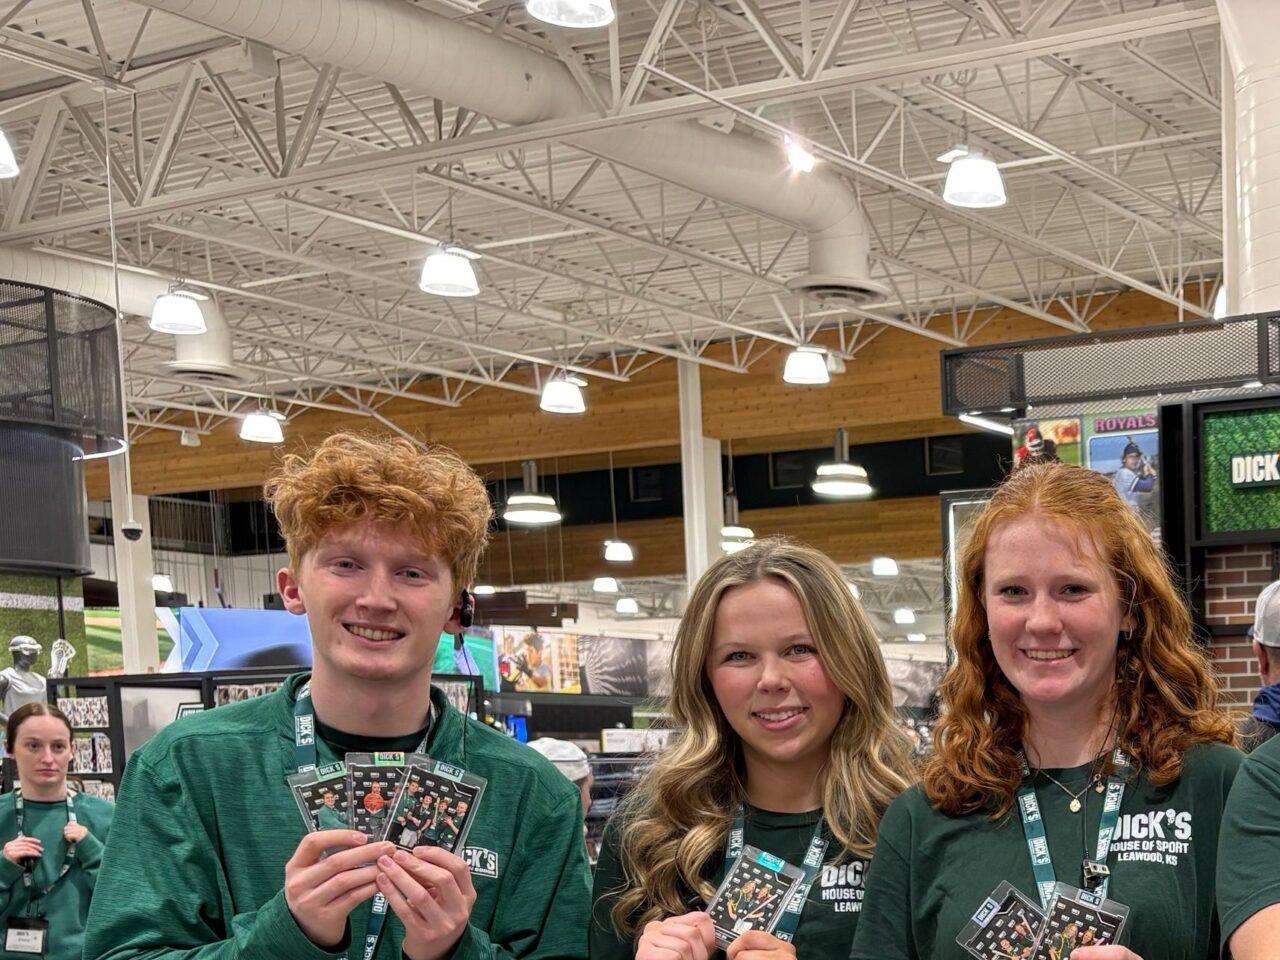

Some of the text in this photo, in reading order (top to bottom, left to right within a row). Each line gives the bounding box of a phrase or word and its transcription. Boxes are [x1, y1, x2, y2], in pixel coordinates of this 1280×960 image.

[1095, 415, 1156, 431] ROYALS
[1141, 841, 1155, 851] OF
[1156, 840, 1189, 854] SPORT
[462, 848, 496, 871] CK'S
[1117, 852, 1178, 866] LEAWOOD, KS
[822, 888, 856, 900] HOUSE
[834, 901, 863, 912] LEAW
